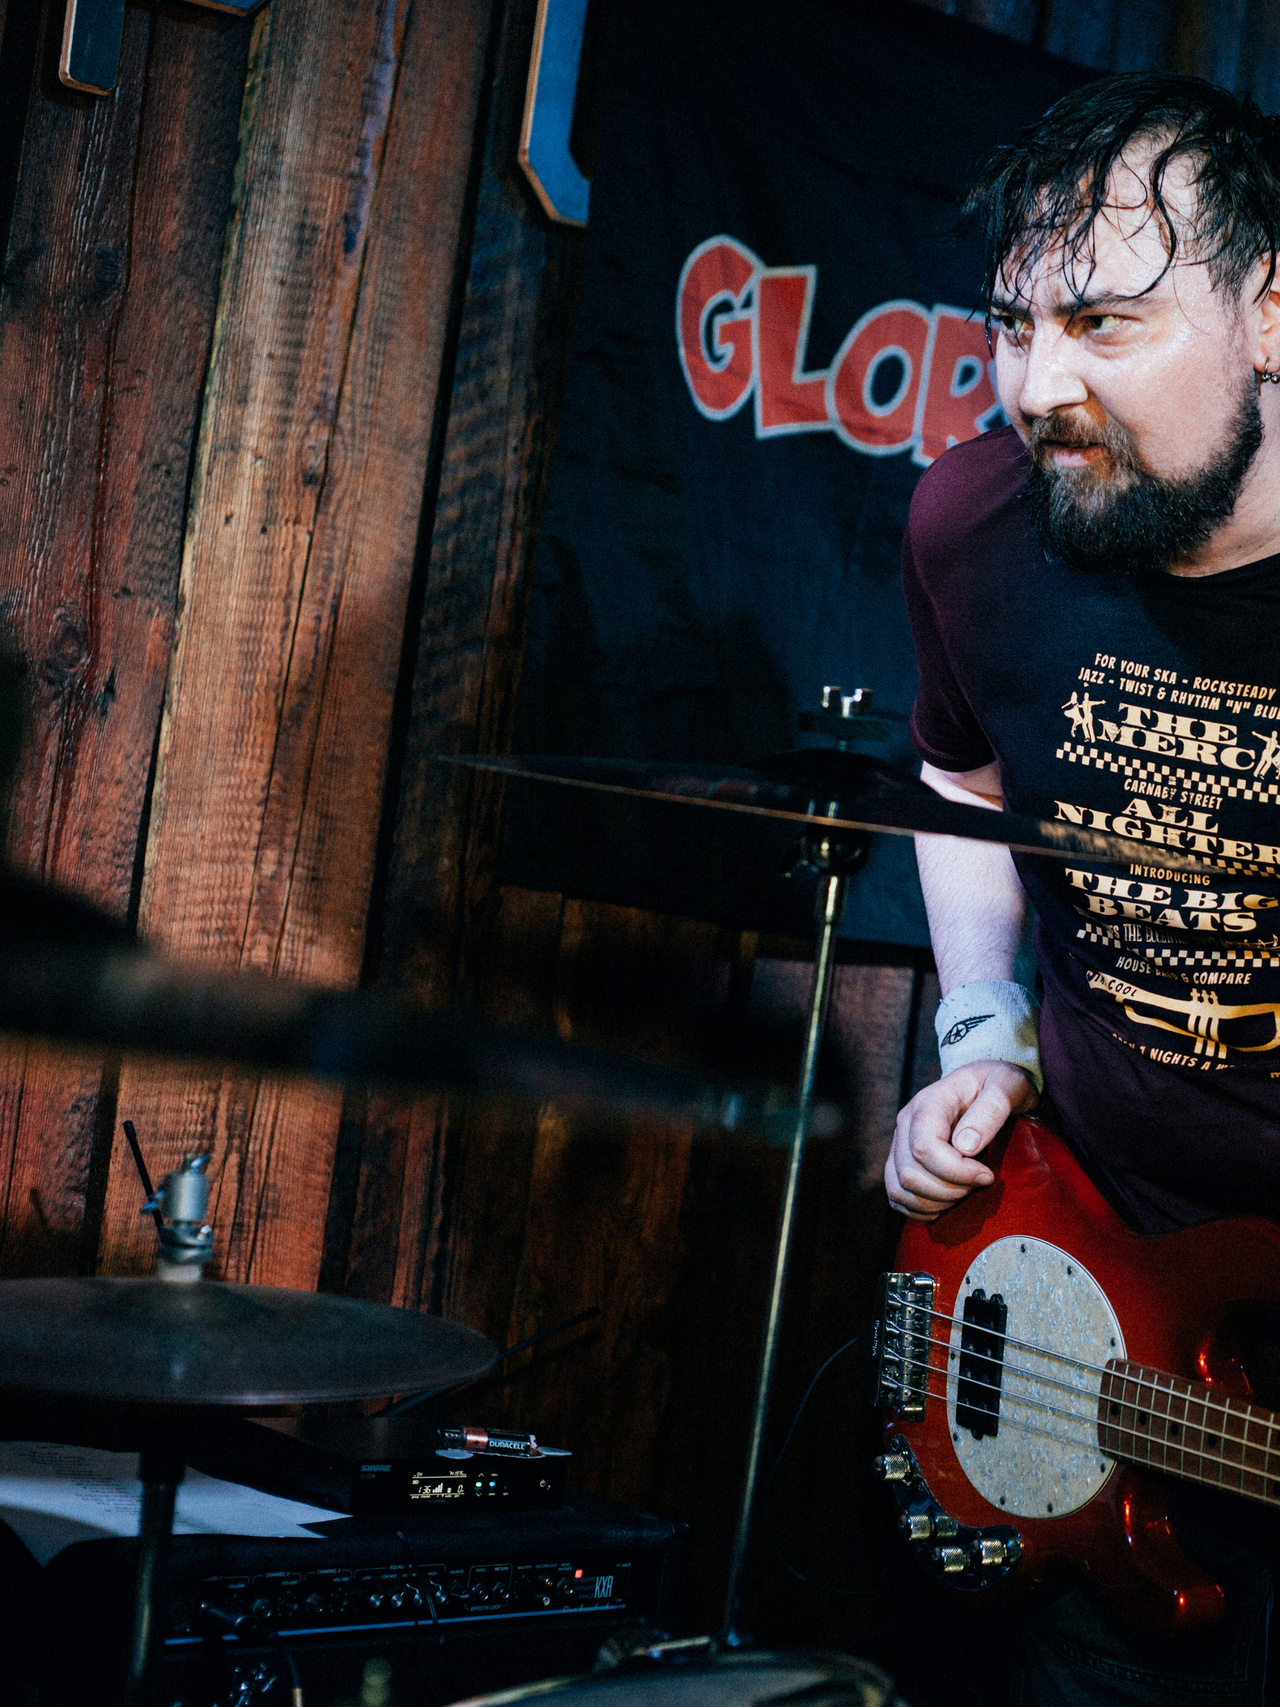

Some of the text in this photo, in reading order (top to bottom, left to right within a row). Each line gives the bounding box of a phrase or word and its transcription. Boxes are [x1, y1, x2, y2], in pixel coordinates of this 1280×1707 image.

[1078, 667, 1104, 685] JAZZ
[1119, 677, 1154, 698] TWIST
[1157, 688, 1166, 700] &
[1170, 689, 1221, 712] RHYTHM
[1226, 699, 1251, 714] "N"
[1094, 652, 1116, 669] FOR
[1120, 659, 1150, 678] YOUR
[1153, 668, 1178, 685] SKA
[1193, 676, 1277, 700] ROCKSTEADY
[1118, 702, 1238, 746] THE
[1097, 718, 1256, 771] MERC
[1123, 778, 1223, 810] CARNABY STREET
[1122, 798, 1219, 834] ALL
[1065, 867, 1280, 911] THE BIG
[1129, 863, 1211, 886] INTRODUCING
[1085, 893, 1258, 933] BEATS
[1123, 923, 1143, 942] THE
[1115, 956, 1151, 974] HOUSE
[1193, 972, 1252, 985] COMPARE
[1109, 979, 1138, 997] COOL
[1149, 1047, 1199, 1068] NIGHTS
[1200, 1060, 1212, 1071] A
[488, 1440, 526, 1450] DURACELL
[360, 1464, 392, 1472] SHURE
[594, 1575, 614, 1599] KXR
